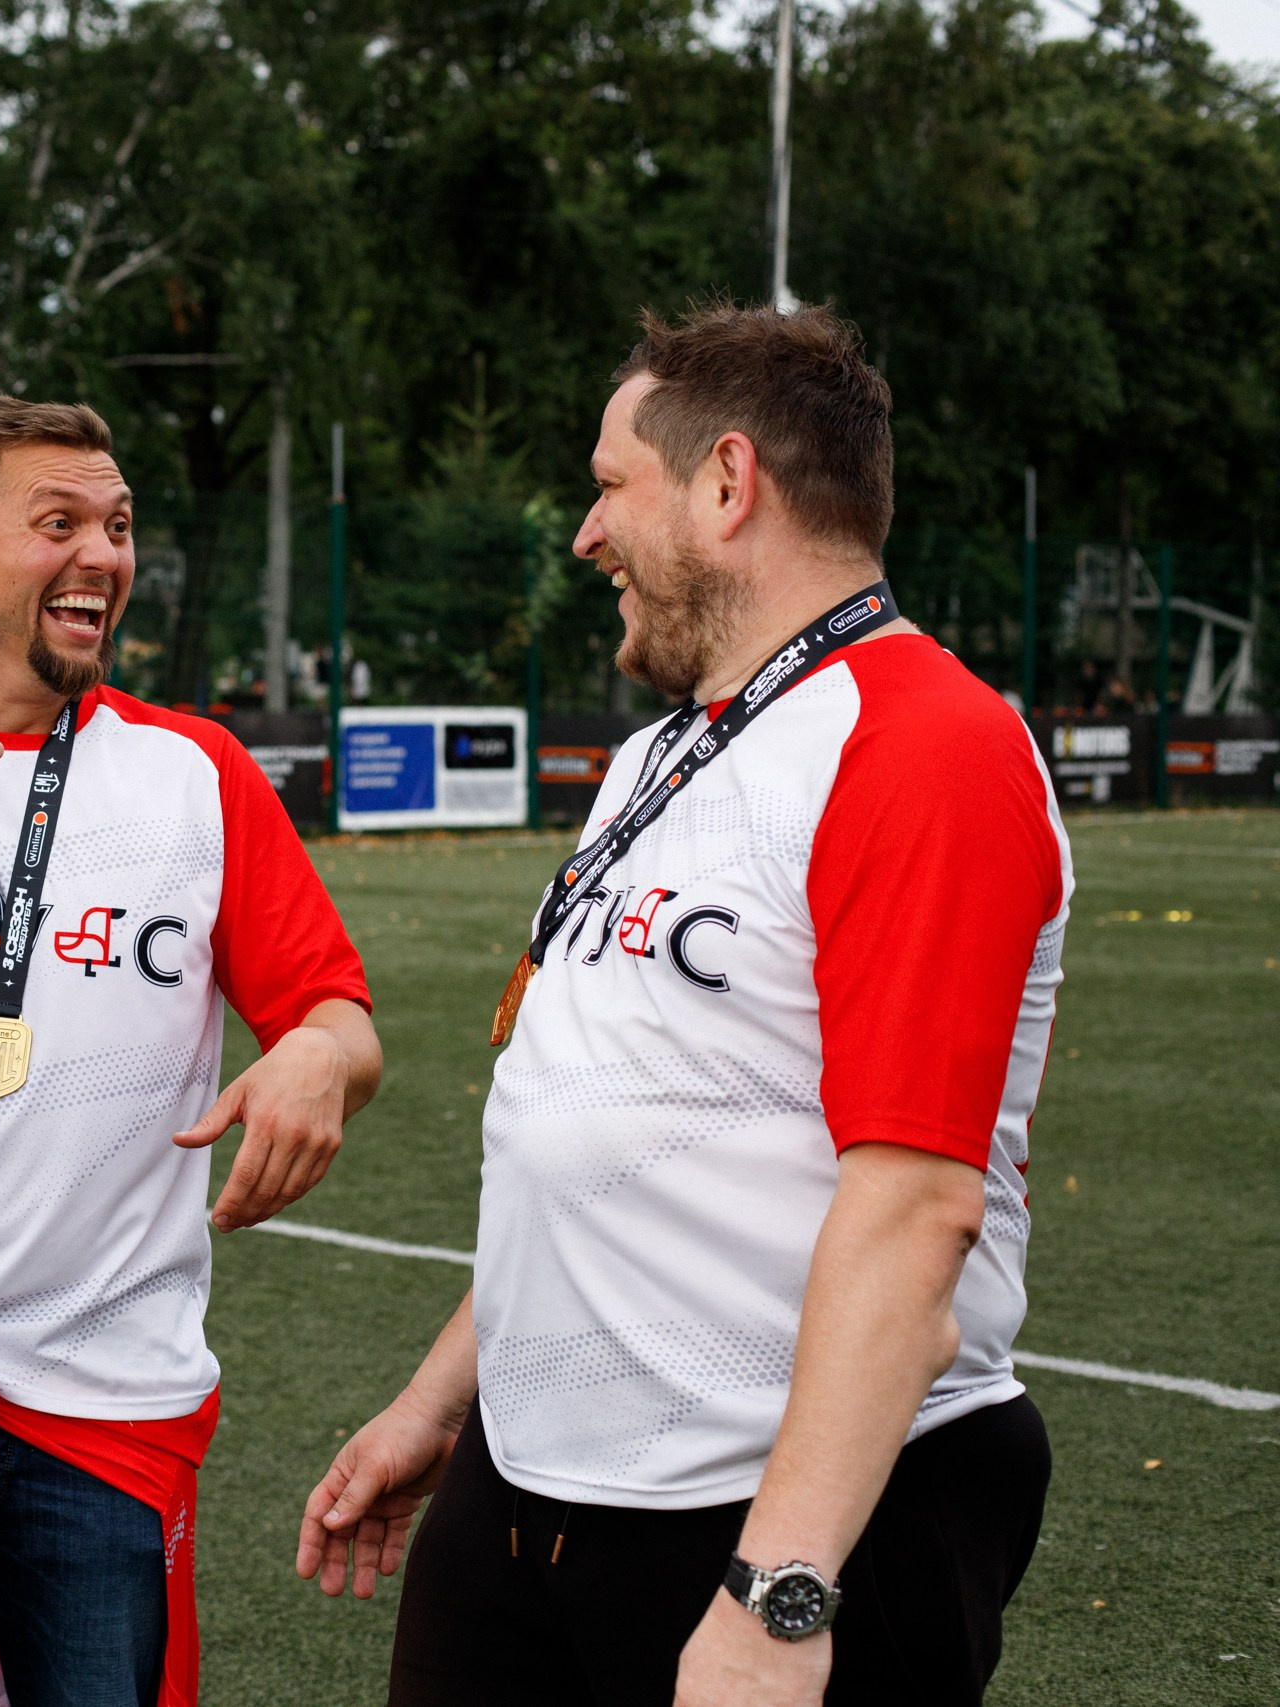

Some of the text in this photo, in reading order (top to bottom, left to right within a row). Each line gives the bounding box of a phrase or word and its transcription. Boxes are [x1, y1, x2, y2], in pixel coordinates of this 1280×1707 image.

[833, 605, 869, 630] Winline
[744, 637, 809, 702] СЕЗОН
[639, 787, 668, 821] Winline
[28, 827, 43, 863] Winline
[2, 887, 28, 971] 3 СЕЗОН
[16, 898, 34, 963] ПОБЕДИТЕЛЬ
